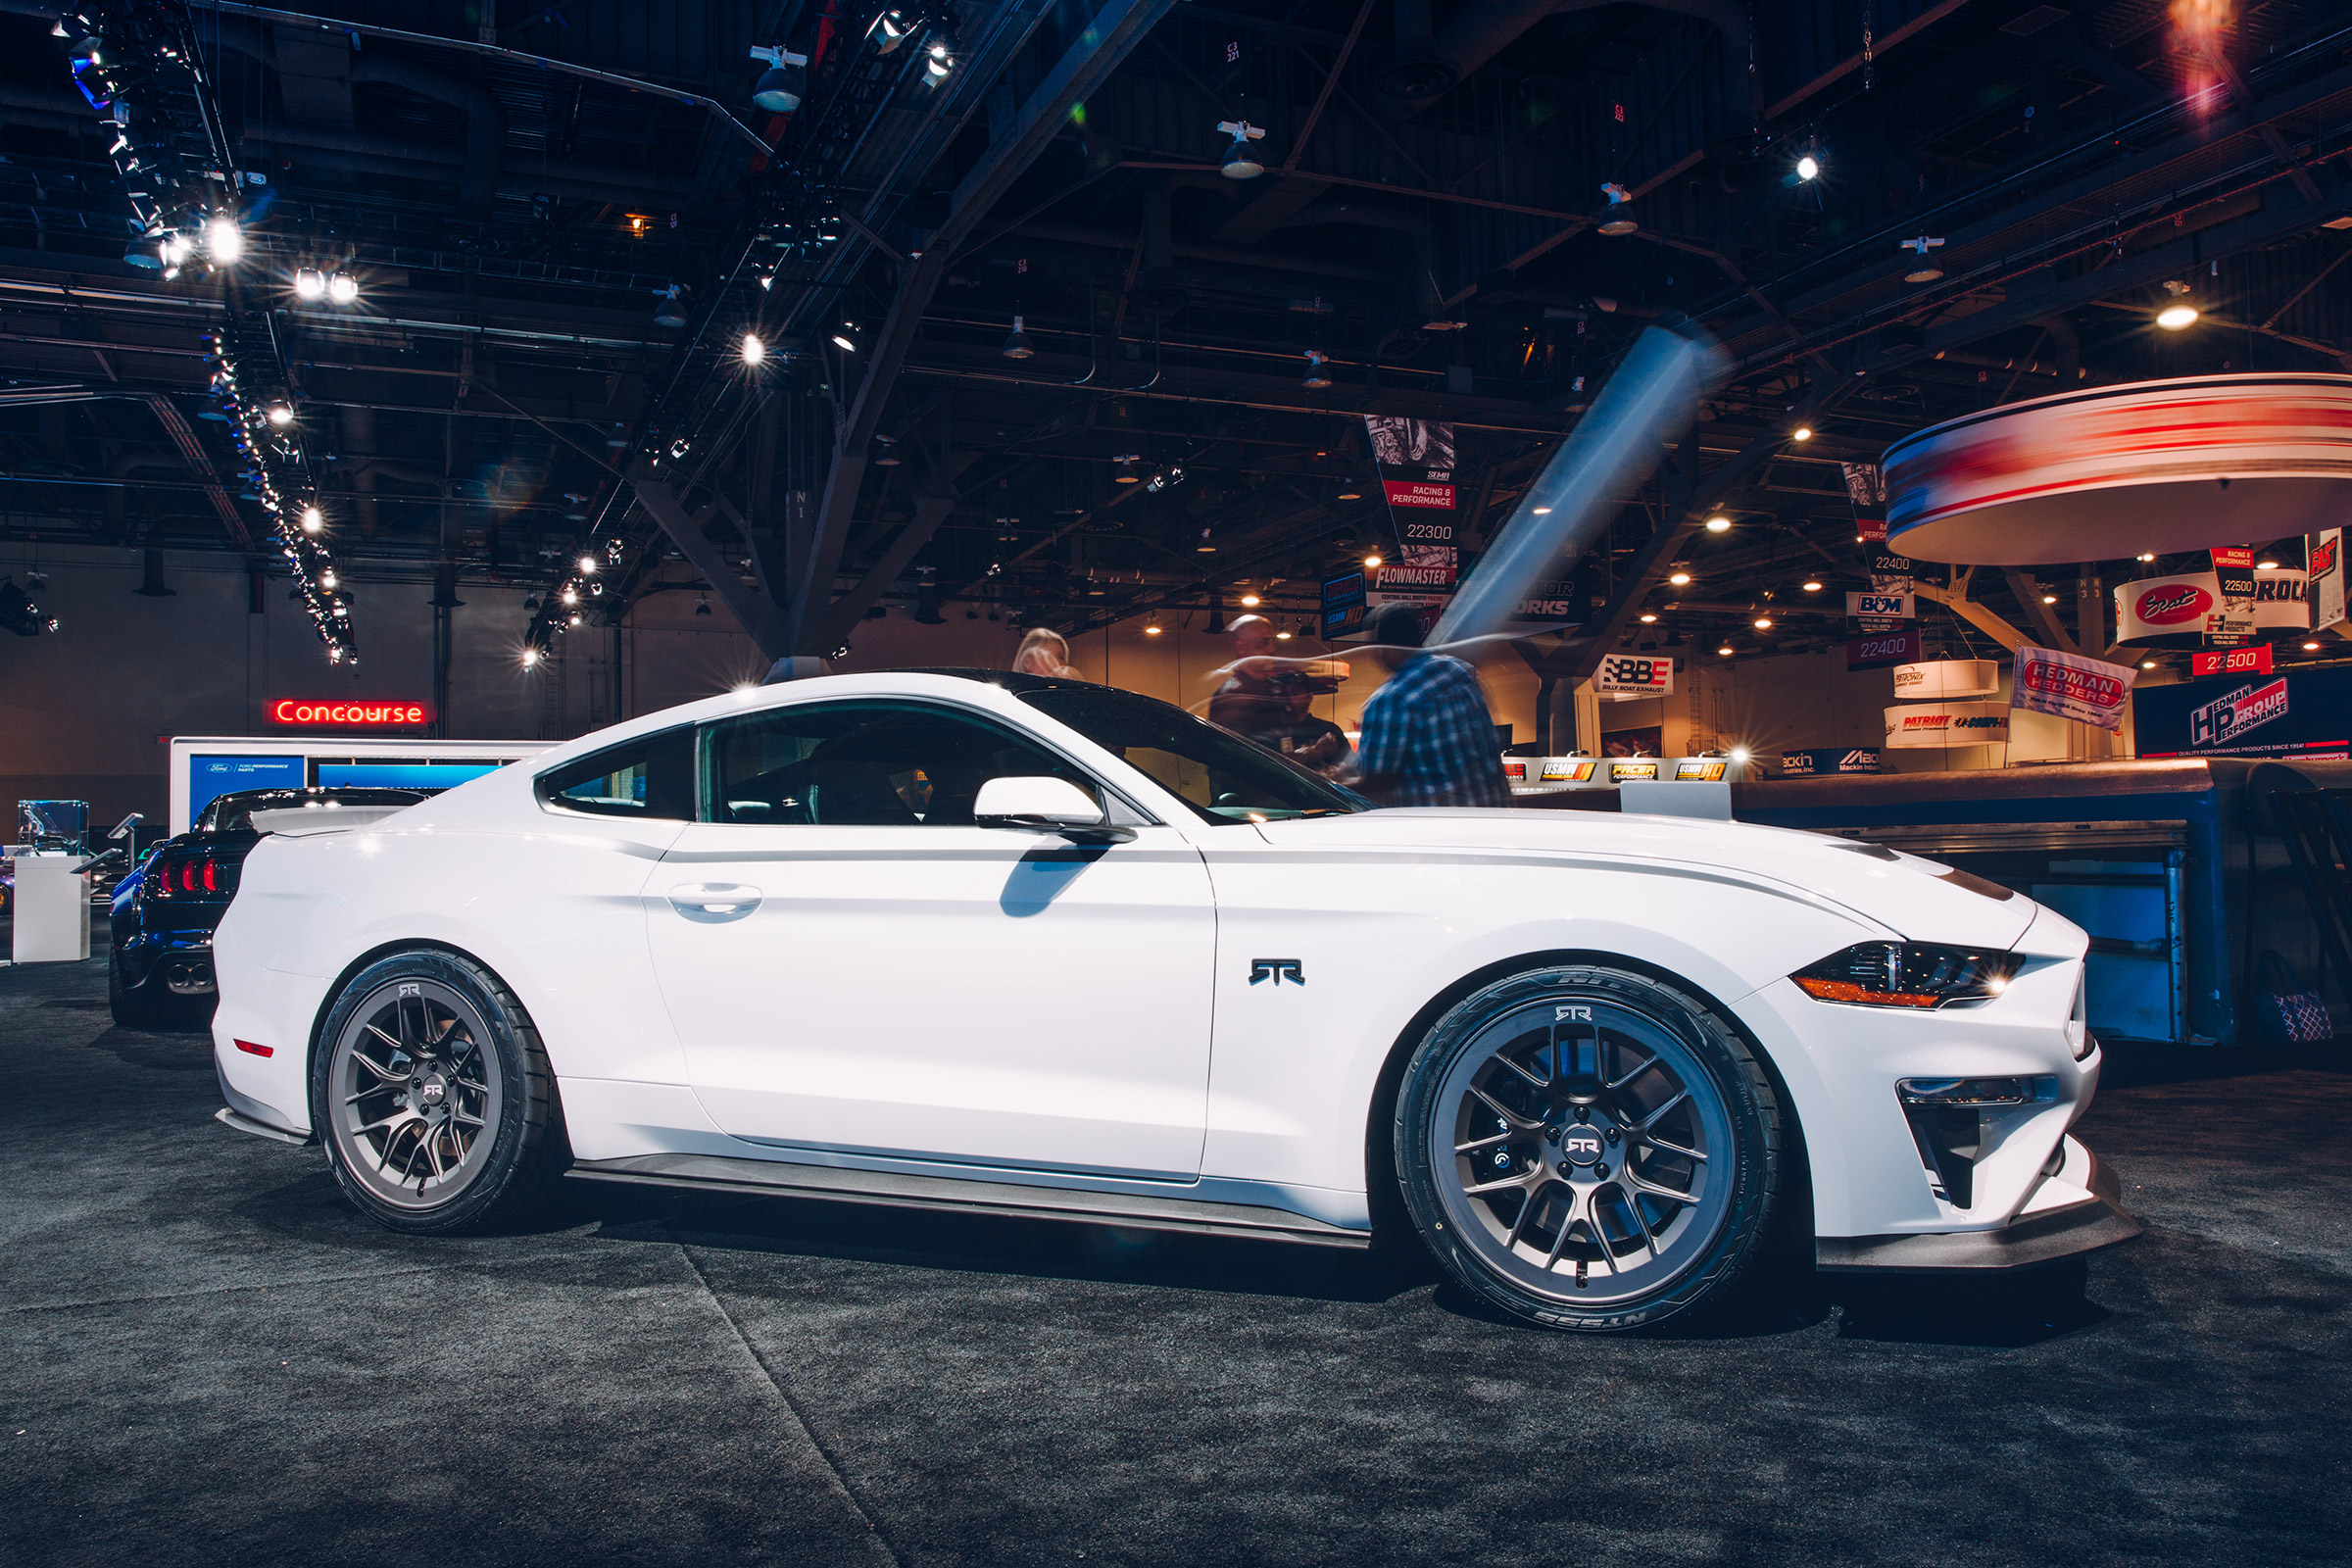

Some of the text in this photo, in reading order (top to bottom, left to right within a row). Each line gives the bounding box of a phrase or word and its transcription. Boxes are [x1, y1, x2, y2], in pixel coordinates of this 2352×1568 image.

[1427, 471, 1450, 480] SEMA
[1392, 494, 1451, 506] PERFORMANCE
[1412, 486, 1450, 497] RACING &
[1407, 523, 1452, 540] 22300
[1876, 557, 1910, 570] 22400
[2216, 557, 2251, 565] PERFORMANCE
[2311, 539, 2336, 576] FAST
[1375, 567, 1447, 589] FLOWMASTER
[2225, 579, 2252, 592] 22500
[2255, 579, 2308, 602] ROCA
[1513, 599, 1570, 615] ORKS
[1859, 596, 1902, 613] B&M
[1860, 638, 1905, 658] 22400
[2207, 653, 2256, 670] 22500
[1616, 659, 1669, 685] BBE
[2034, 663, 2115, 694] HEDMAN
[2032, 677, 2109, 704] HEDDERS
[277, 701, 422, 721] Concourse
[2193, 686, 2251, 743] HEDMAN
[2233, 691, 2286, 723] GROUP
[1902, 715, 1951, 727] PATRIOT
[2214, 702, 2286, 743] PERFORMANCE
[1544, 763, 1579, 774] USMW
[1612, 764, 1656, 774] PACER
[1783, 753, 1813, 768] ackin
[1679, 763, 1725, 777] USMW HD
